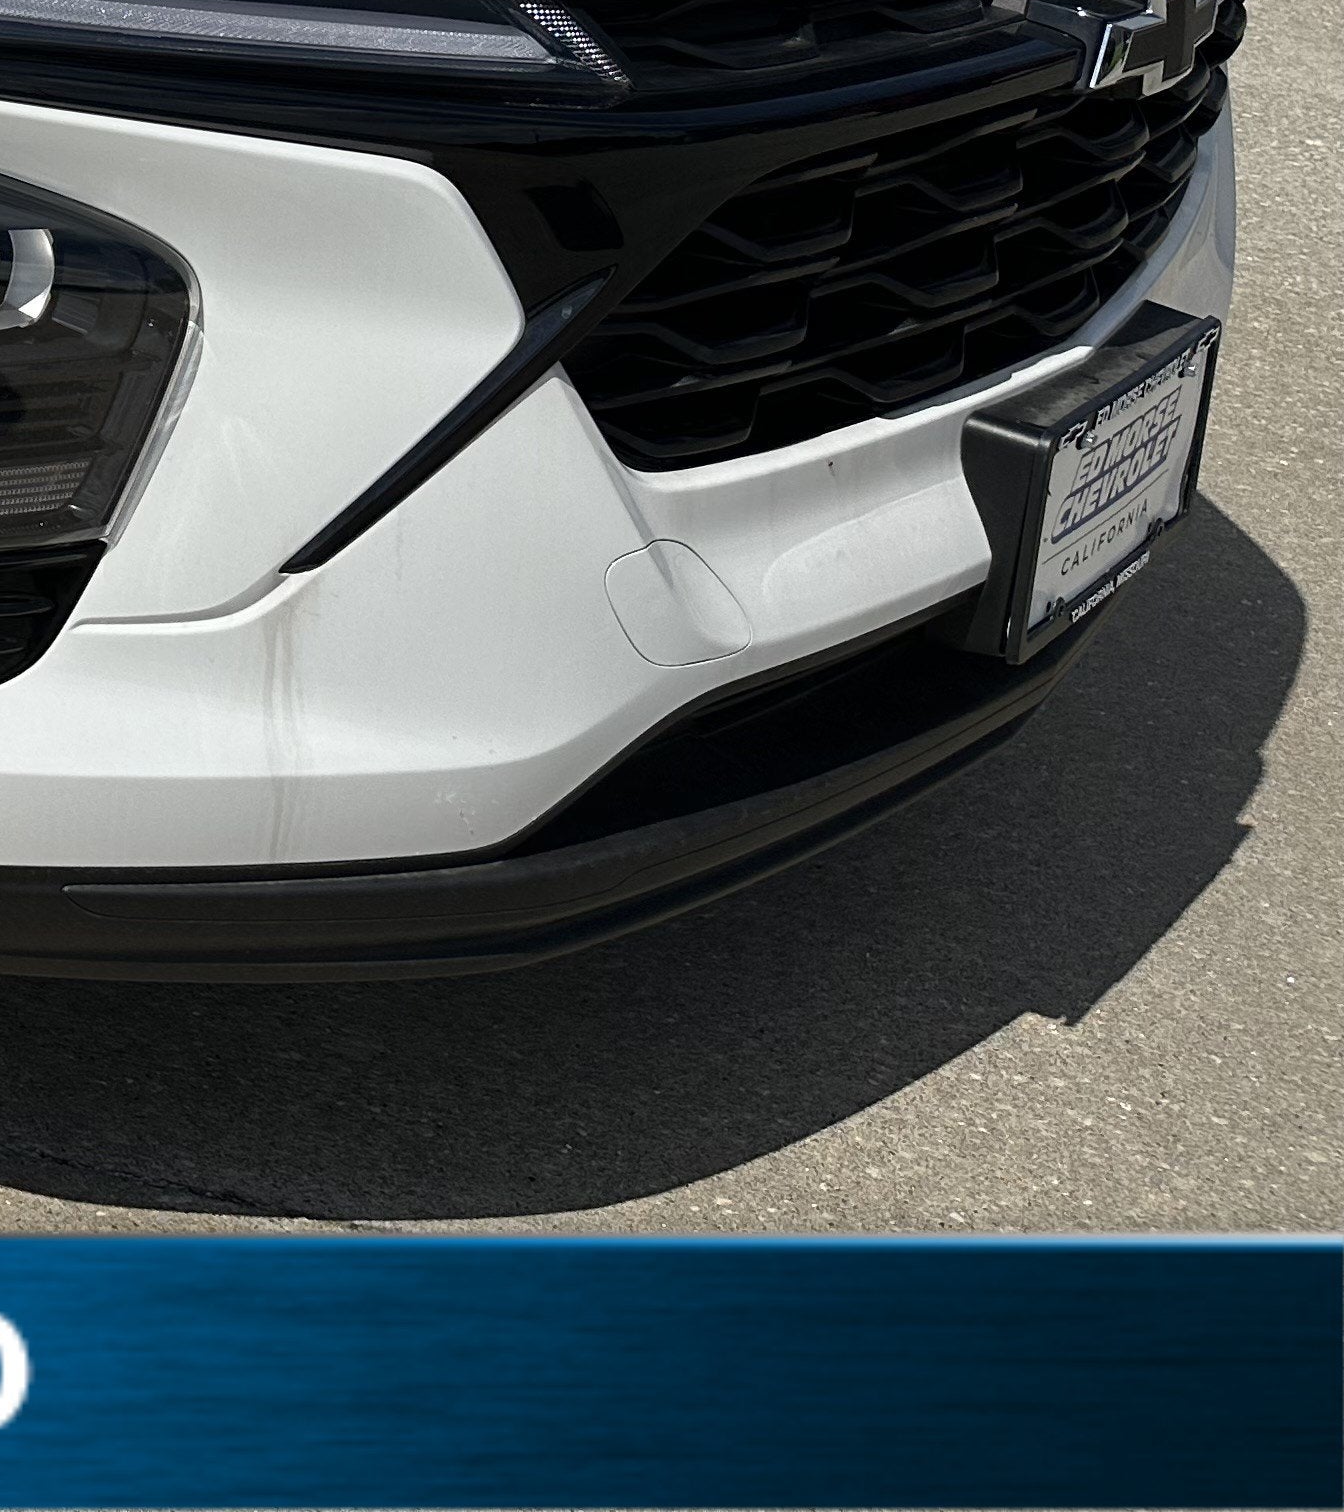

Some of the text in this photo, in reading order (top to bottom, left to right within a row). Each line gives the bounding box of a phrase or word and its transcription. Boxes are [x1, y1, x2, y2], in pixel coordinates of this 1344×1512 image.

[1052, 415, 1182, 543] CHEVROLET
[1072, 385, 1183, 494] ED MORSE
[1061, 498, 1148, 576] CALIFORNIA
